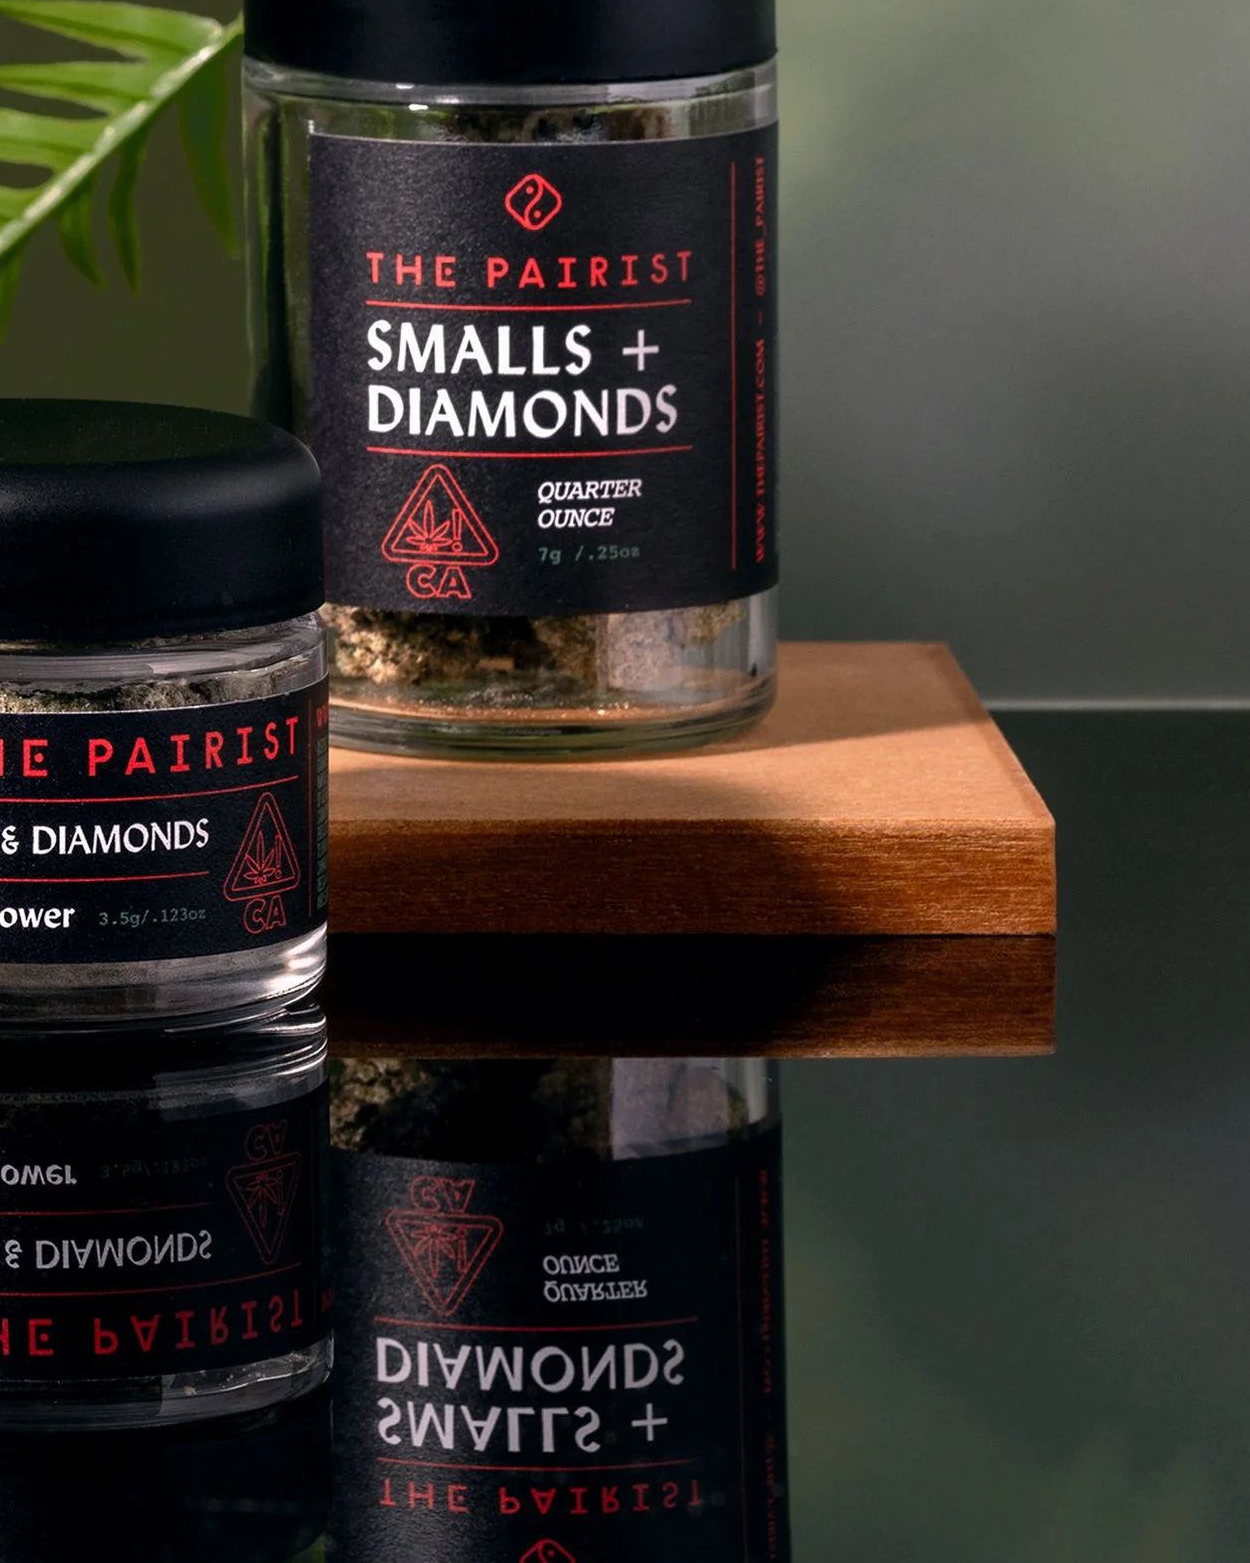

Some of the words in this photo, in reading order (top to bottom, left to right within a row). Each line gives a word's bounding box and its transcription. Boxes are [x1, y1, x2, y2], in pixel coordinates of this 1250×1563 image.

[366, 251, 456, 288] THE
[487, 251, 691, 289] PAIRIST
[367, 319, 592, 376] SMALLS
[622, 329, 659, 371] +
[368, 384, 677, 439] DIAMONDS
[537, 479, 642, 504] QUARTER
[537, 507, 615, 529] OUNCE
[538, 547, 562, 565] 7g
[405, 563, 474, 599] CA
[88, 716, 299, 777] PAIRIST
[1, 825, 20, 855] &
[32, 817, 209, 855] DIAMONDS
[99, 907, 206, 928] 3.5g/.123oz
[242, 897, 288, 935] CA
